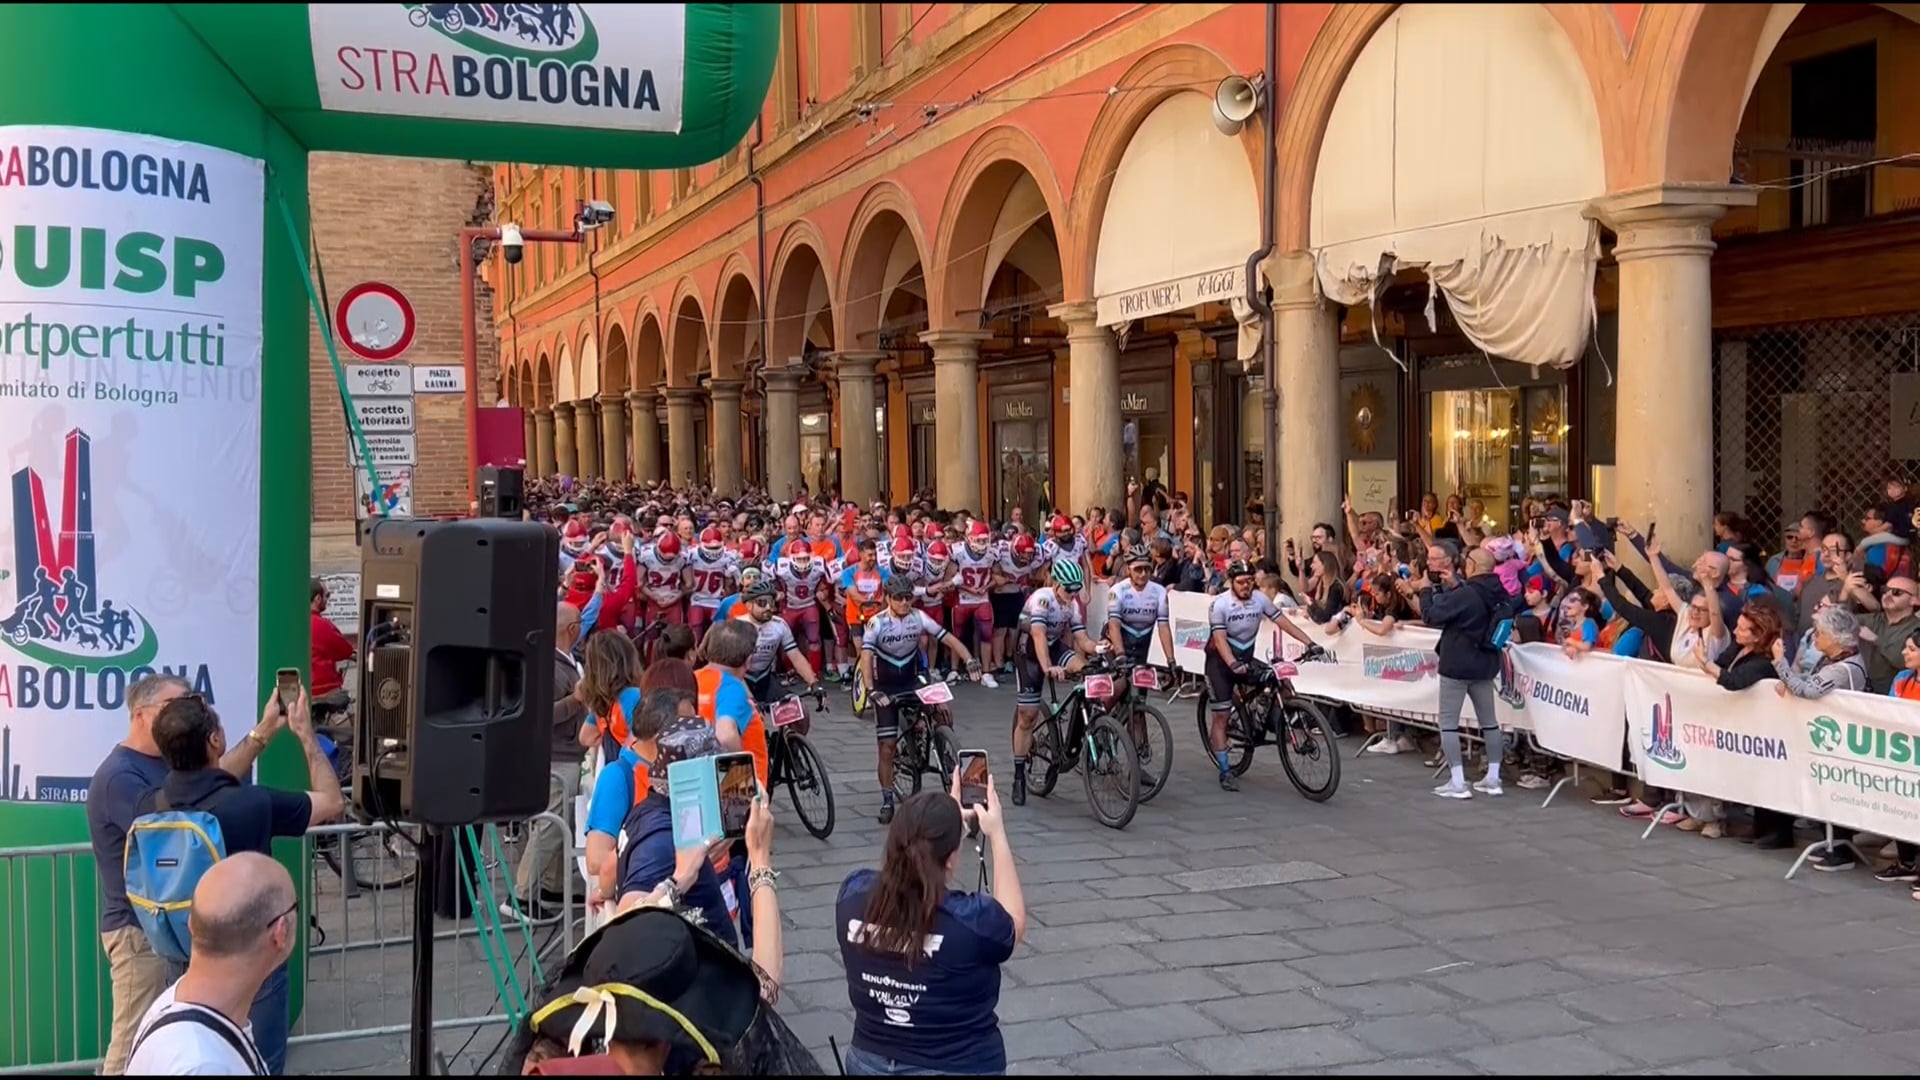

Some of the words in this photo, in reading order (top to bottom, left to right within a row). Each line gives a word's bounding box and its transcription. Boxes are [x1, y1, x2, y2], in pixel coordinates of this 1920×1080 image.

[337, 46, 660, 112] STRABOLOGNA
[0, 145, 210, 204] ABOLOGNA
[14, 225, 225, 298] UISP
[0, 312, 225, 370] rtpertutti
[358, 368, 400, 378] eccetto
[429, 369, 451, 378] PIAZZA
[67, 381, 85, 400] di
[94, 382, 178, 408] Bologna
[359, 416, 410, 425] utorizzati
[361, 405, 404, 415] eccetto
[694, 571, 726, 593] 76
[962, 567, 991, 587] 67
[1514, 671, 1589, 716] TRABOLOGNA
[1683, 723, 1788, 761] STRABOLOGNA
[41, 788, 88, 802] STRABO
[1882, 803, 1919, 820] Bologna
